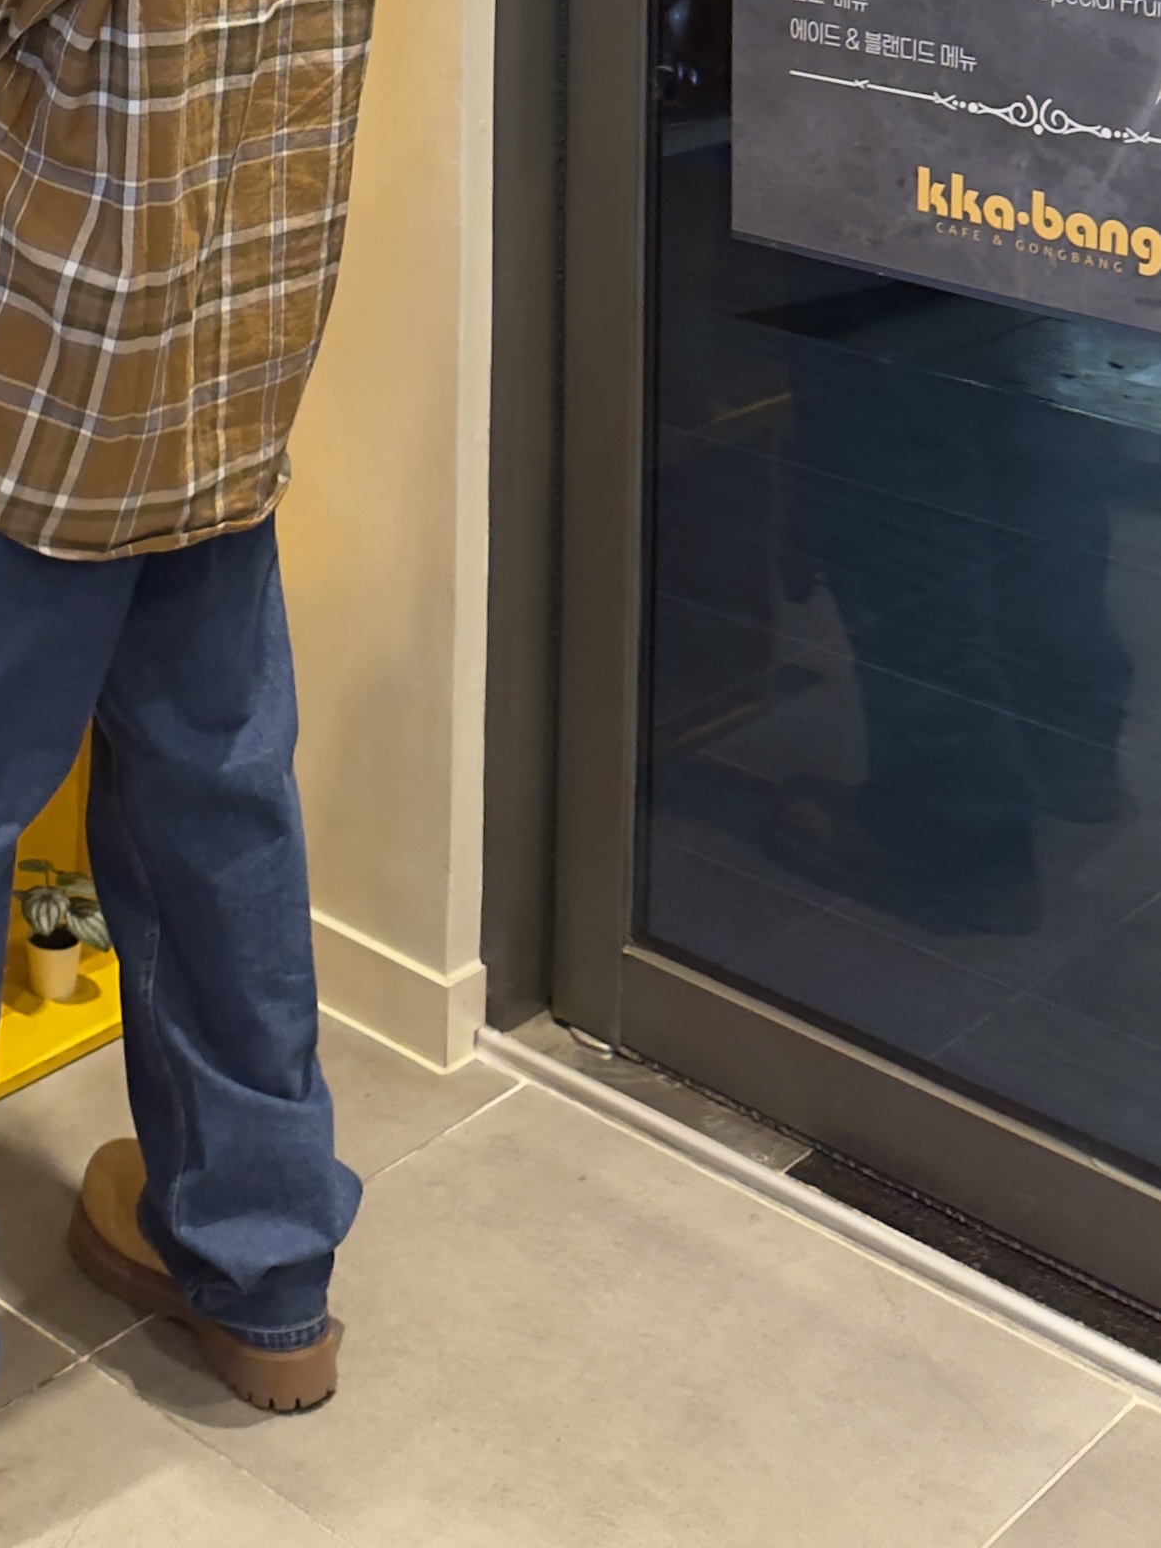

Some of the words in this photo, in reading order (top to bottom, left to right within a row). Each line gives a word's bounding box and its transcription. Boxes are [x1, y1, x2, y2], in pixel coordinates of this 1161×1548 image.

[790, 17, 841, 47] 에이드
[845, 27, 860, 51] &
[864, 30, 936, 64] 블랜디드
[940, 44, 977, 73] 메뉴
[935, 221, 981, 242] CAFE
[1015, 239, 1124, 274] GONGBANG
